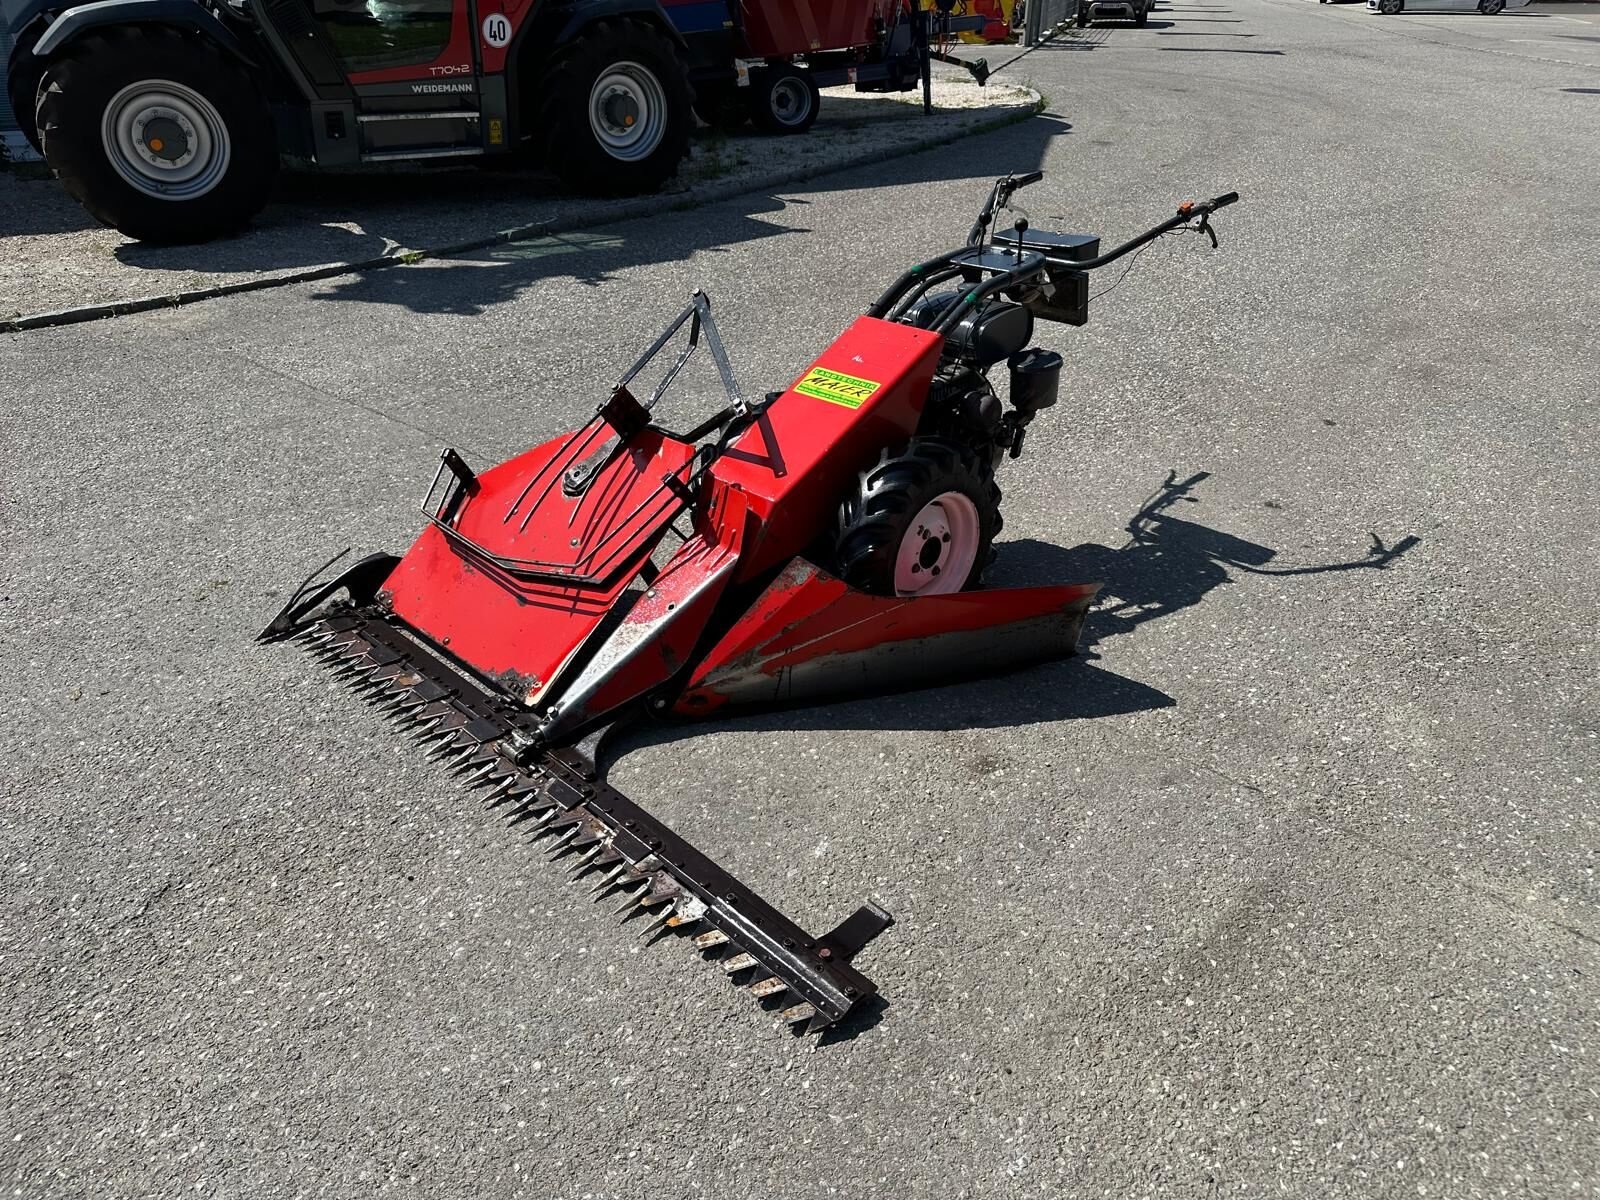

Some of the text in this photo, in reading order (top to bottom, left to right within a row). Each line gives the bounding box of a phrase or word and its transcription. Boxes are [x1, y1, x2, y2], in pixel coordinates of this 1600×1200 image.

[489, 20, 506, 41] 40
[429, 64, 470, 76] T7042
[412, 84, 473, 93] WEIDEMANN
[804, 377, 872, 397] MAIER
[814, 369, 876, 390] LANDTECHNIK
